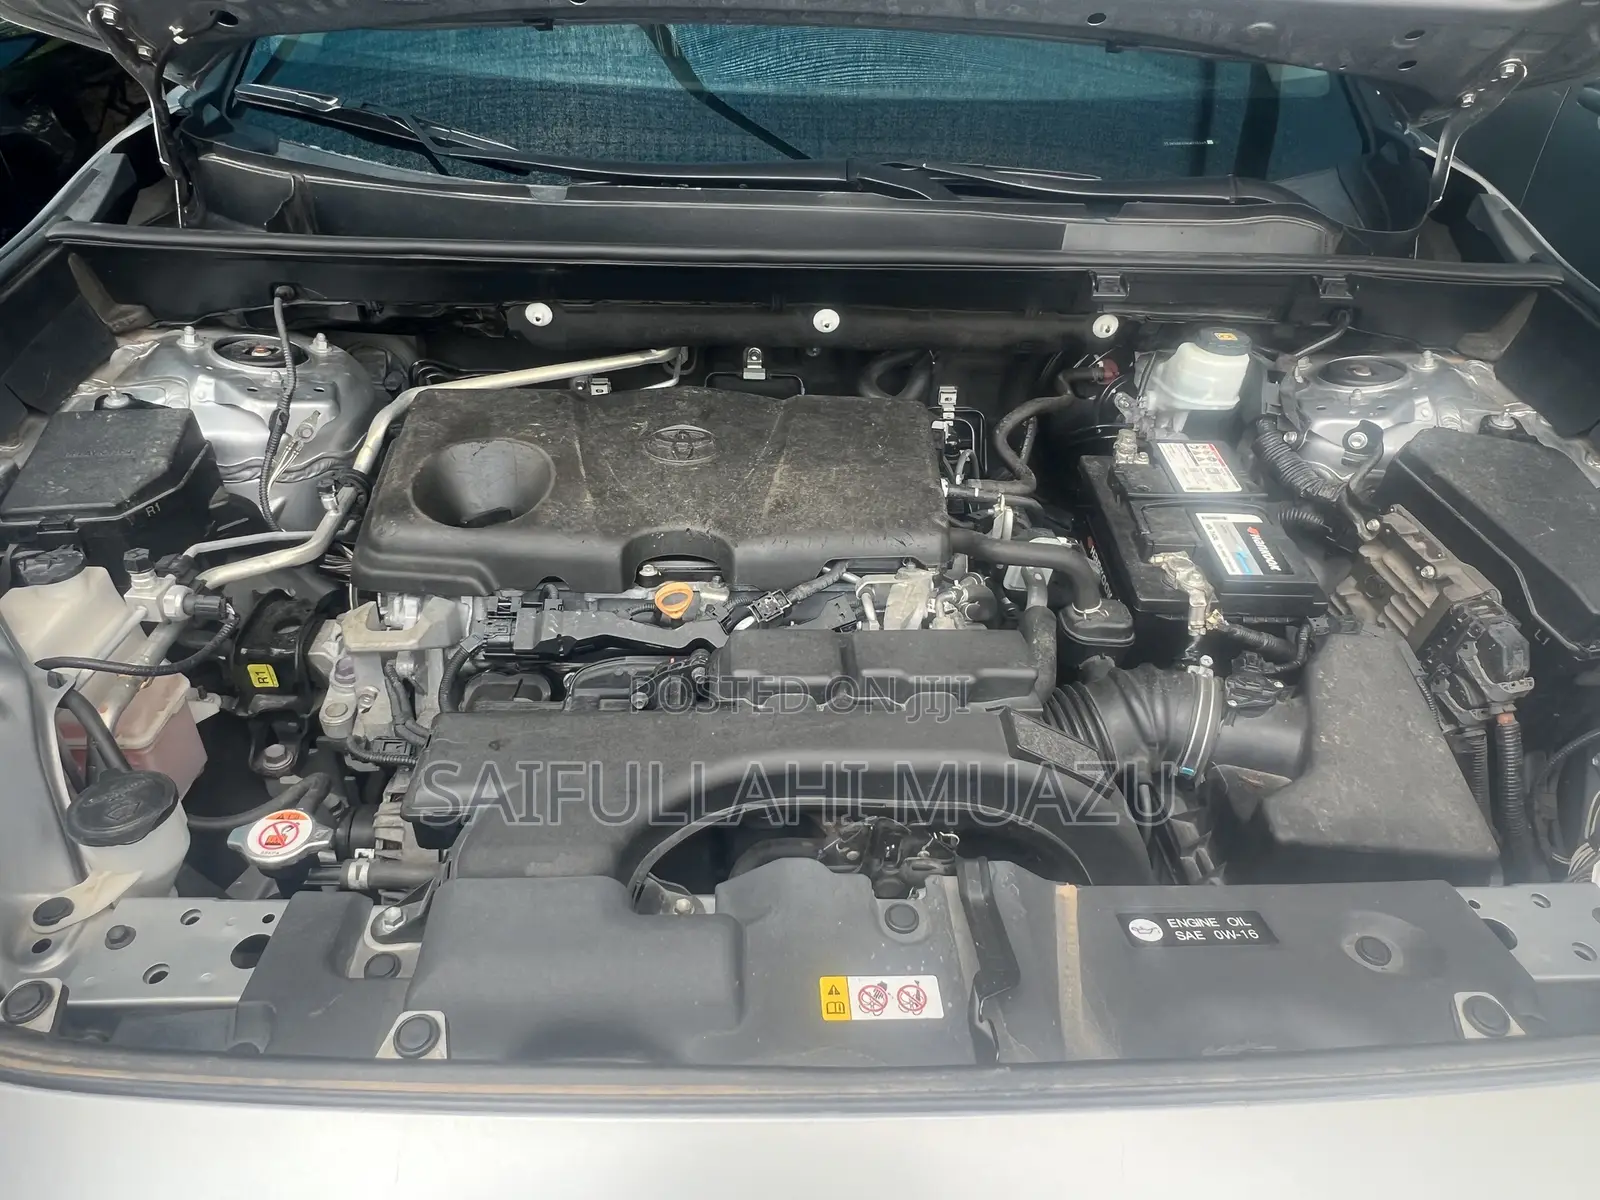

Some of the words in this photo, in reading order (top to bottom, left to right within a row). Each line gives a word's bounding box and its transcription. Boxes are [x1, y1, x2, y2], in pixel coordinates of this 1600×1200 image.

[145, 502, 161, 517] R1
[254, 671, 270, 684] R1
[1166, 917, 1220, 928] ENGINE
[1226, 916, 1252, 927] OIL
[1175, 930, 1207, 941] SAE
[1213, 929, 1260, 940] 0W-16
